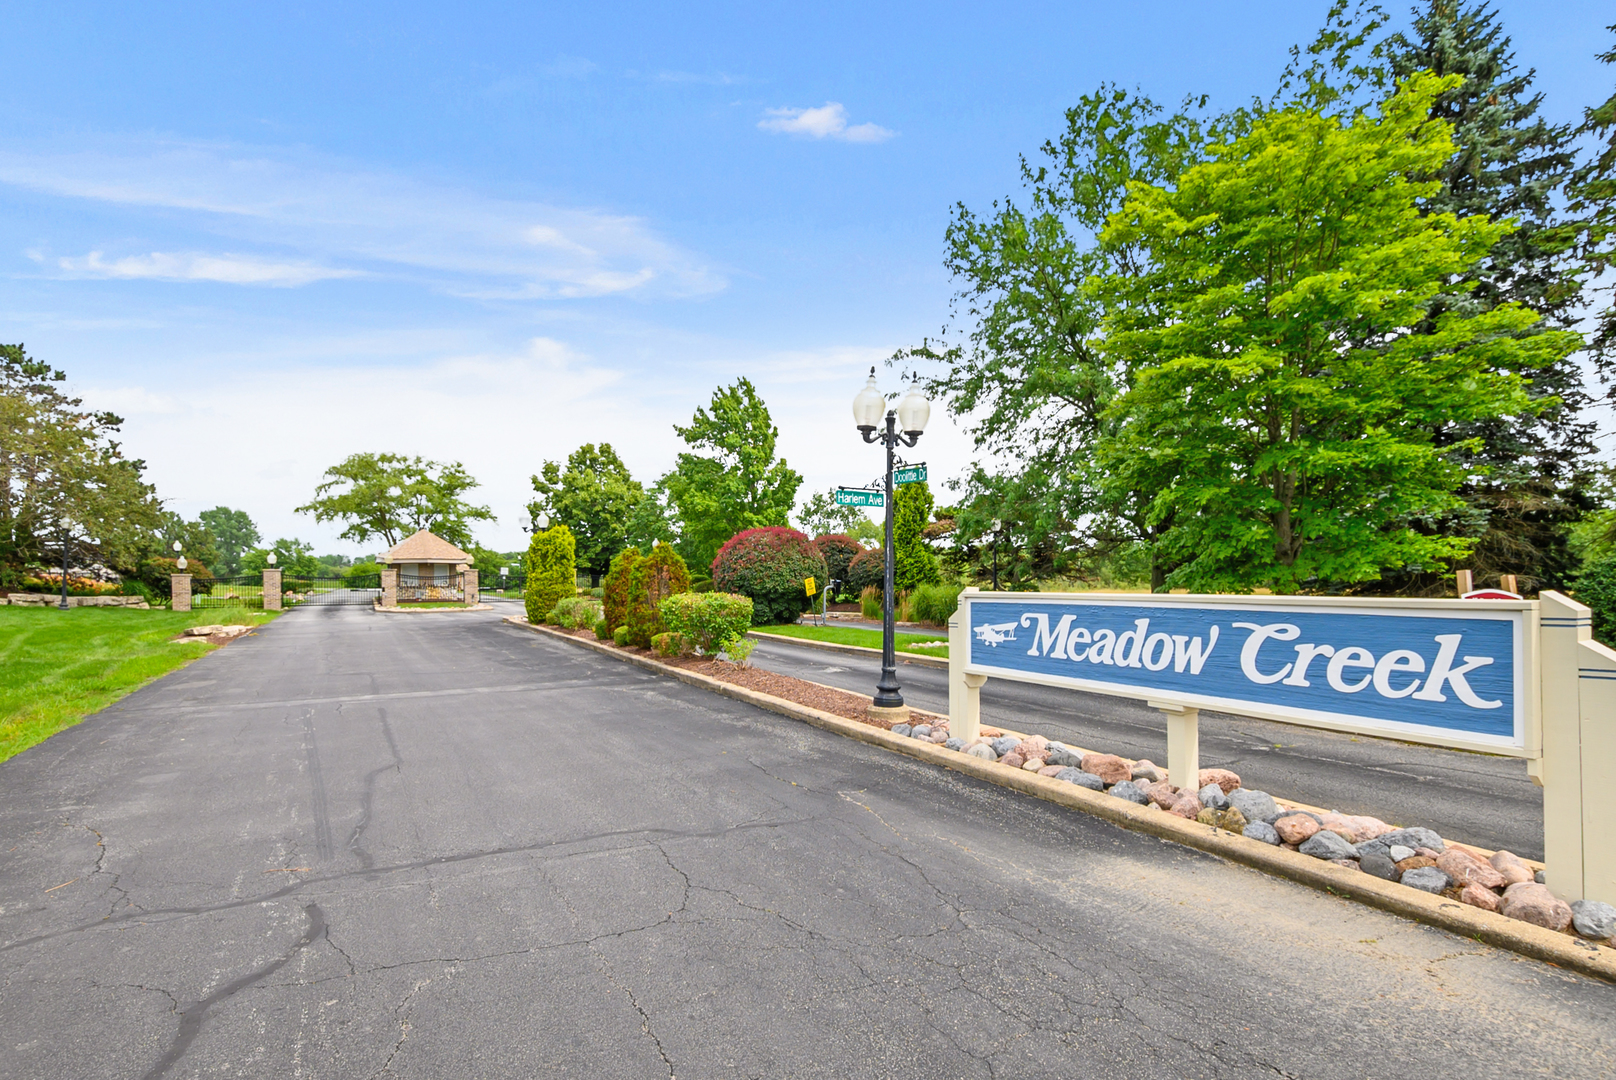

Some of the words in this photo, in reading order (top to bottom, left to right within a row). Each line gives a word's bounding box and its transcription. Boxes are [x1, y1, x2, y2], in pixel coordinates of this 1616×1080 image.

[894, 470, 917, 483] Doolittle
[918, 469, 927, 480] Dr
[837, 492, 866, 504] Harlem
[868, 494, 883, 506] Ave
[1020, 612, 1220, 675] Meadow
[1231, 622, 1503, 709] Creek
